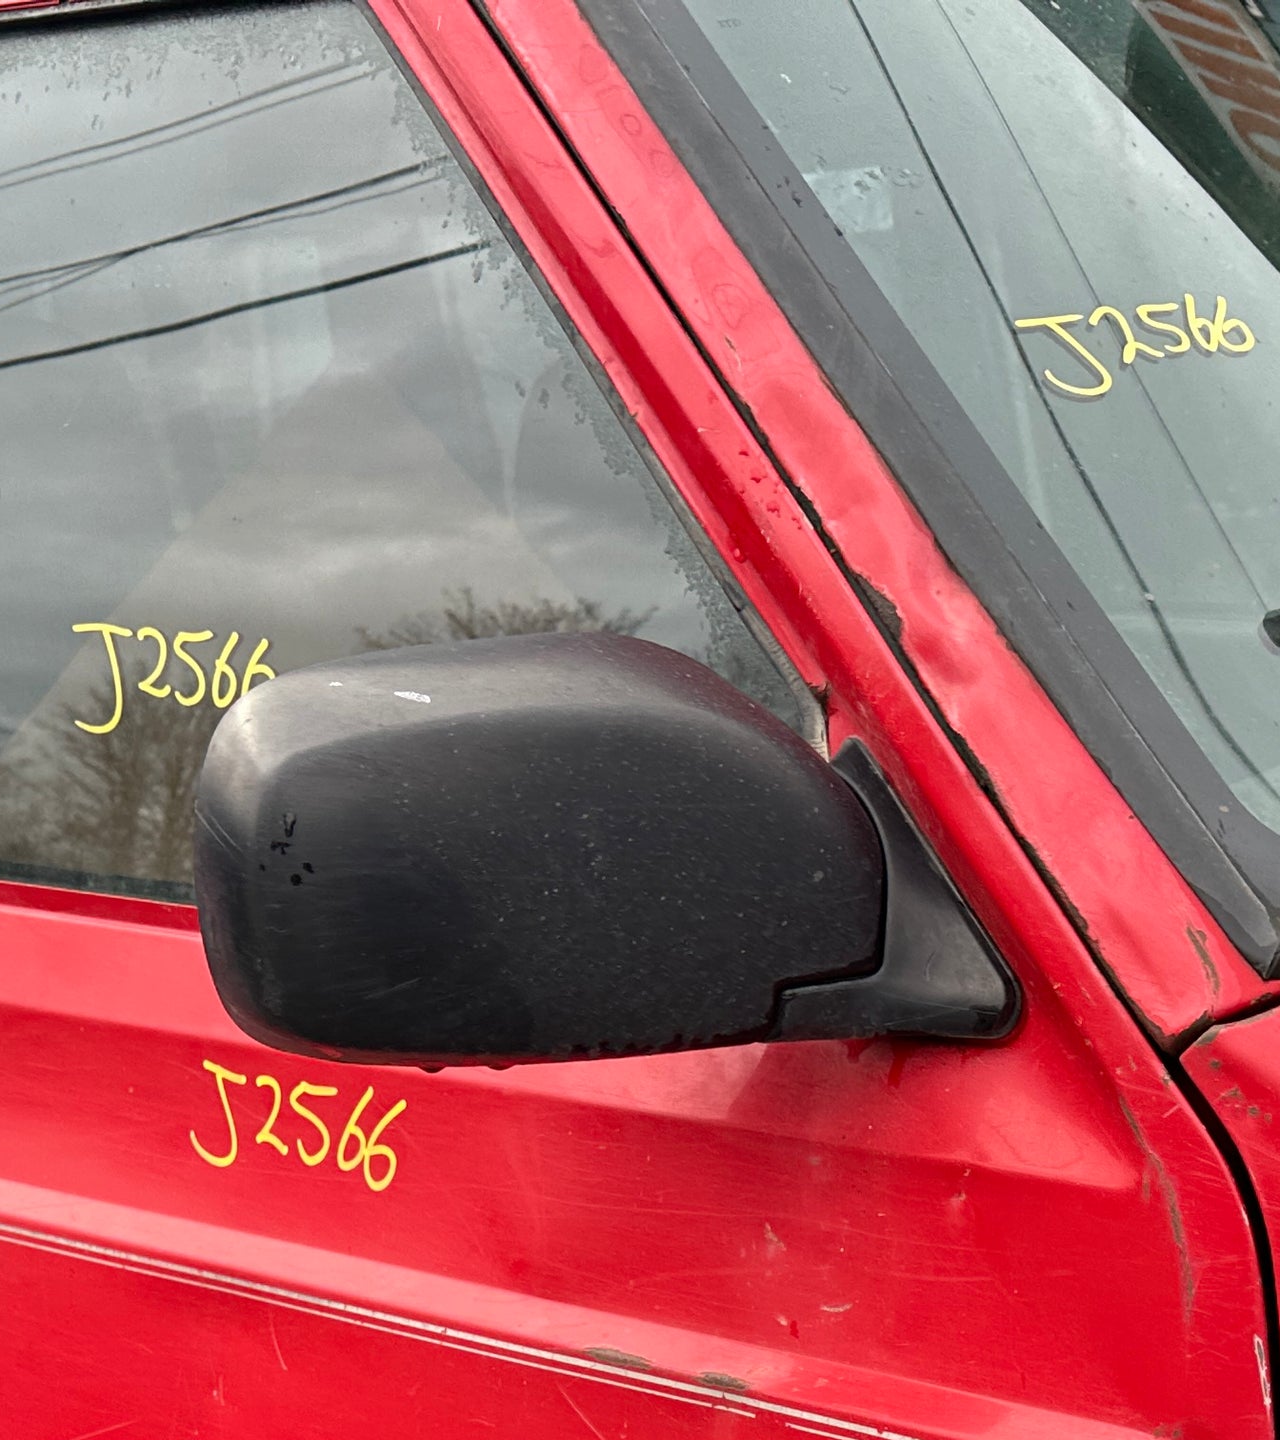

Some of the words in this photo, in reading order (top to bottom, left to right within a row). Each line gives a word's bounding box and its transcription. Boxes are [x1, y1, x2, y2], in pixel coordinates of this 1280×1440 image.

[1014, 292, 1256, 397] J2566
[72, 622, 277, 735] J2566
[189, 1059, 408, 1193] J2566
